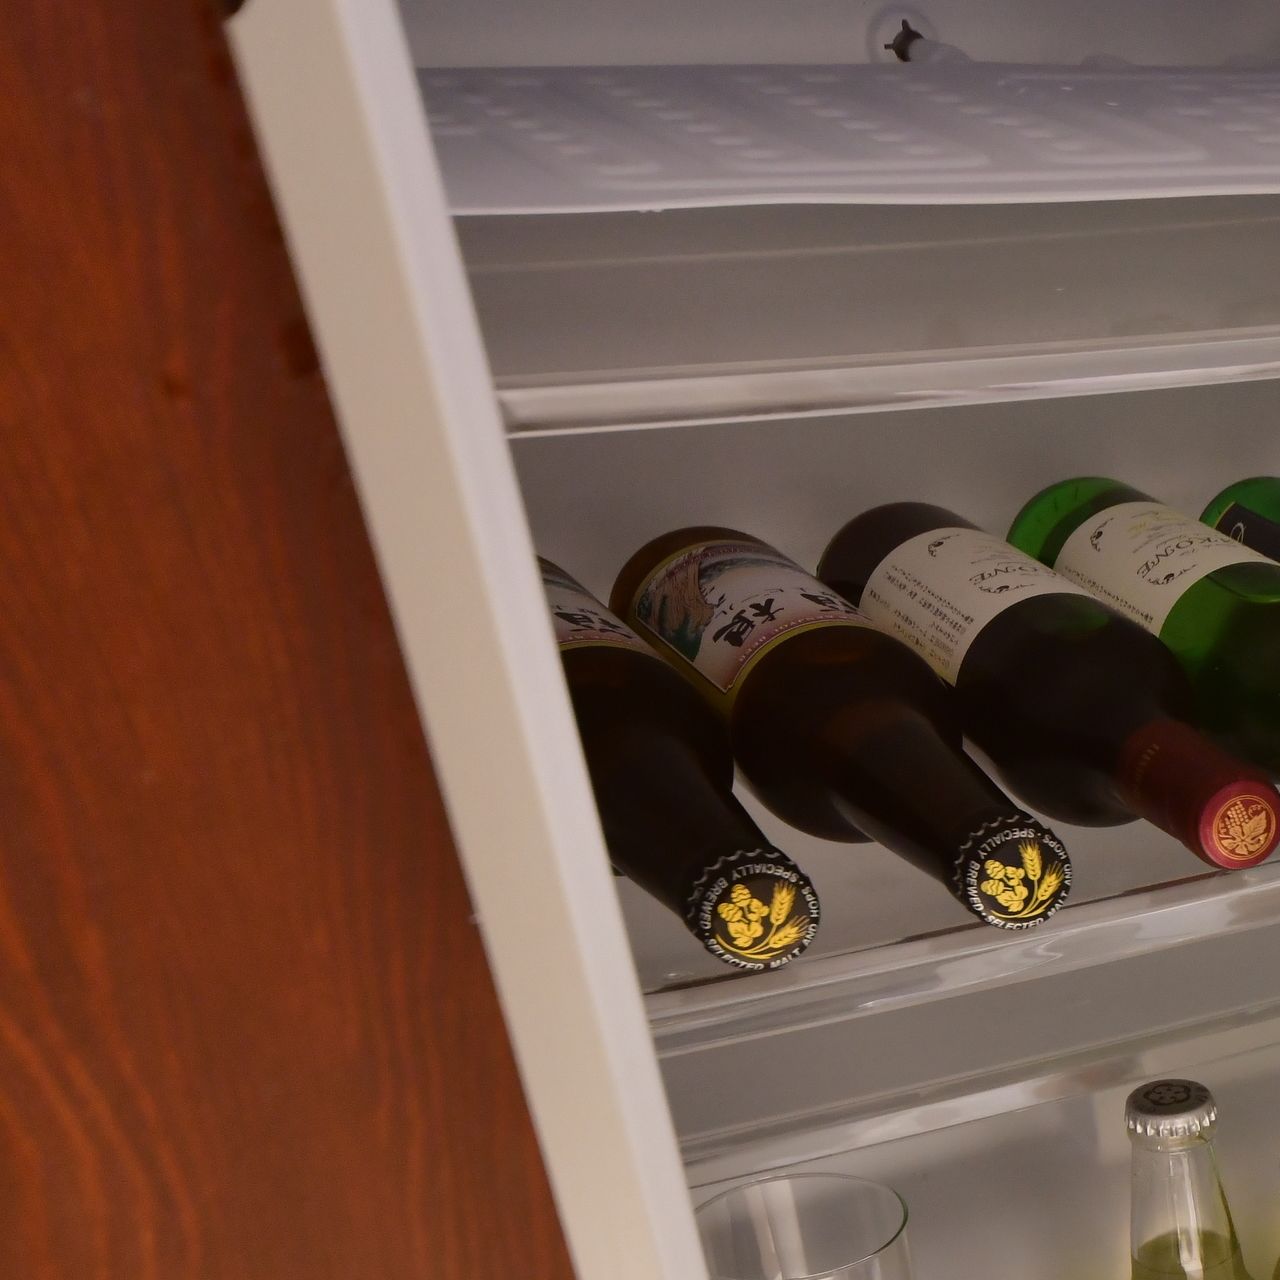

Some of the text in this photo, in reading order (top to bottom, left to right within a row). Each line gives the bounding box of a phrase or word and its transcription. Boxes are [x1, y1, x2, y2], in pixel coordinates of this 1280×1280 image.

[976, 827, 1036, 860] SPECIALLY
[1042, 834, 1067, 860] HOPS
[731, 862, 800, 883] SPECIALLY
[966, 860, 985, 912] BREWED
[699, 877, 729, 930] BREWED
[801, 886, 820, 918] HOPS
[984, 915, 1045, 931] SELECTED
